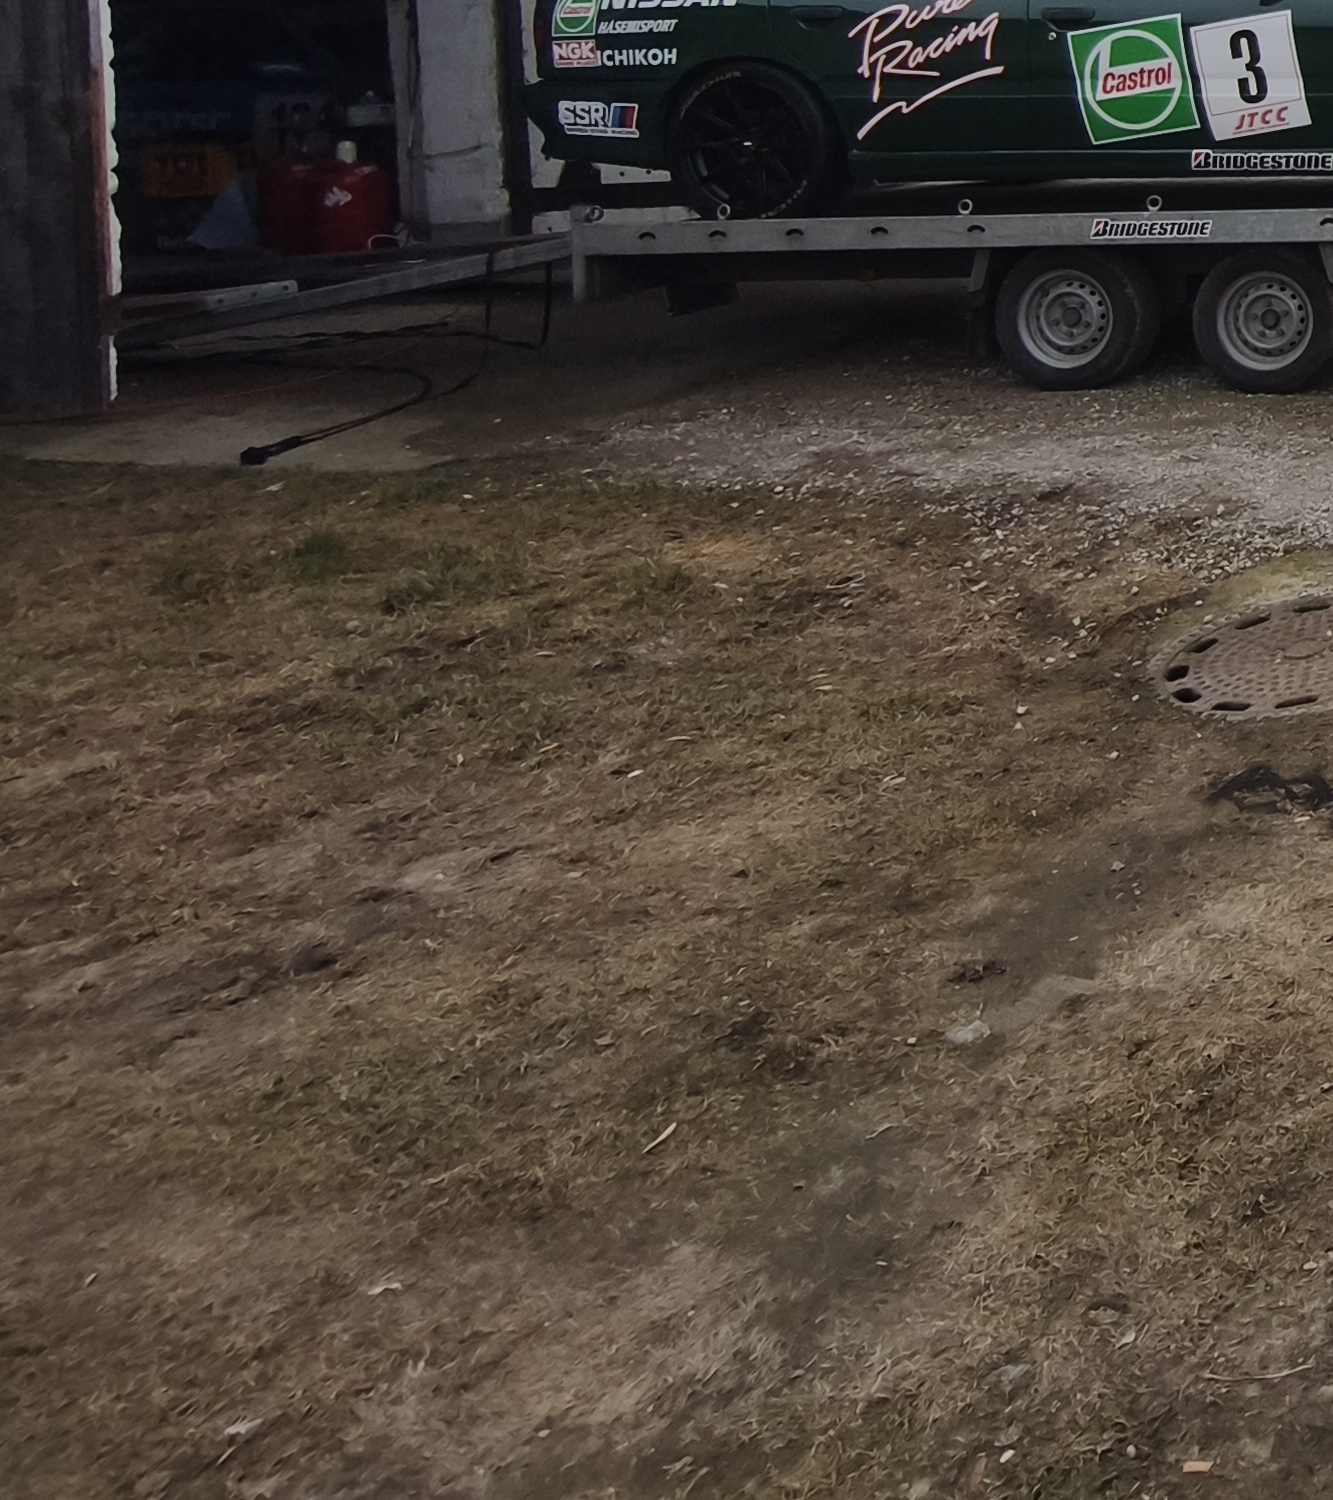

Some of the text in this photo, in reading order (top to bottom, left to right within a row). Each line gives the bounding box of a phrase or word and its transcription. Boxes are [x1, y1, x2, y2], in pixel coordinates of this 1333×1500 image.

[553, 42, 595, 60] NGK
[597, 48, 678, 66] ICHIKOH
[857, 12, 1000, 103] Racing
[1229, 29, 1269, 104] 3
[1102, 62, 1172, 95] Castrol
[560, 103, 605, 125] SSR
[1235, 106, 1289, 131] JTCC
[1193, 151, 1332, 169] BRIDGESTONE
[1091, 220, 1211, 238] BRIDGESTONE
